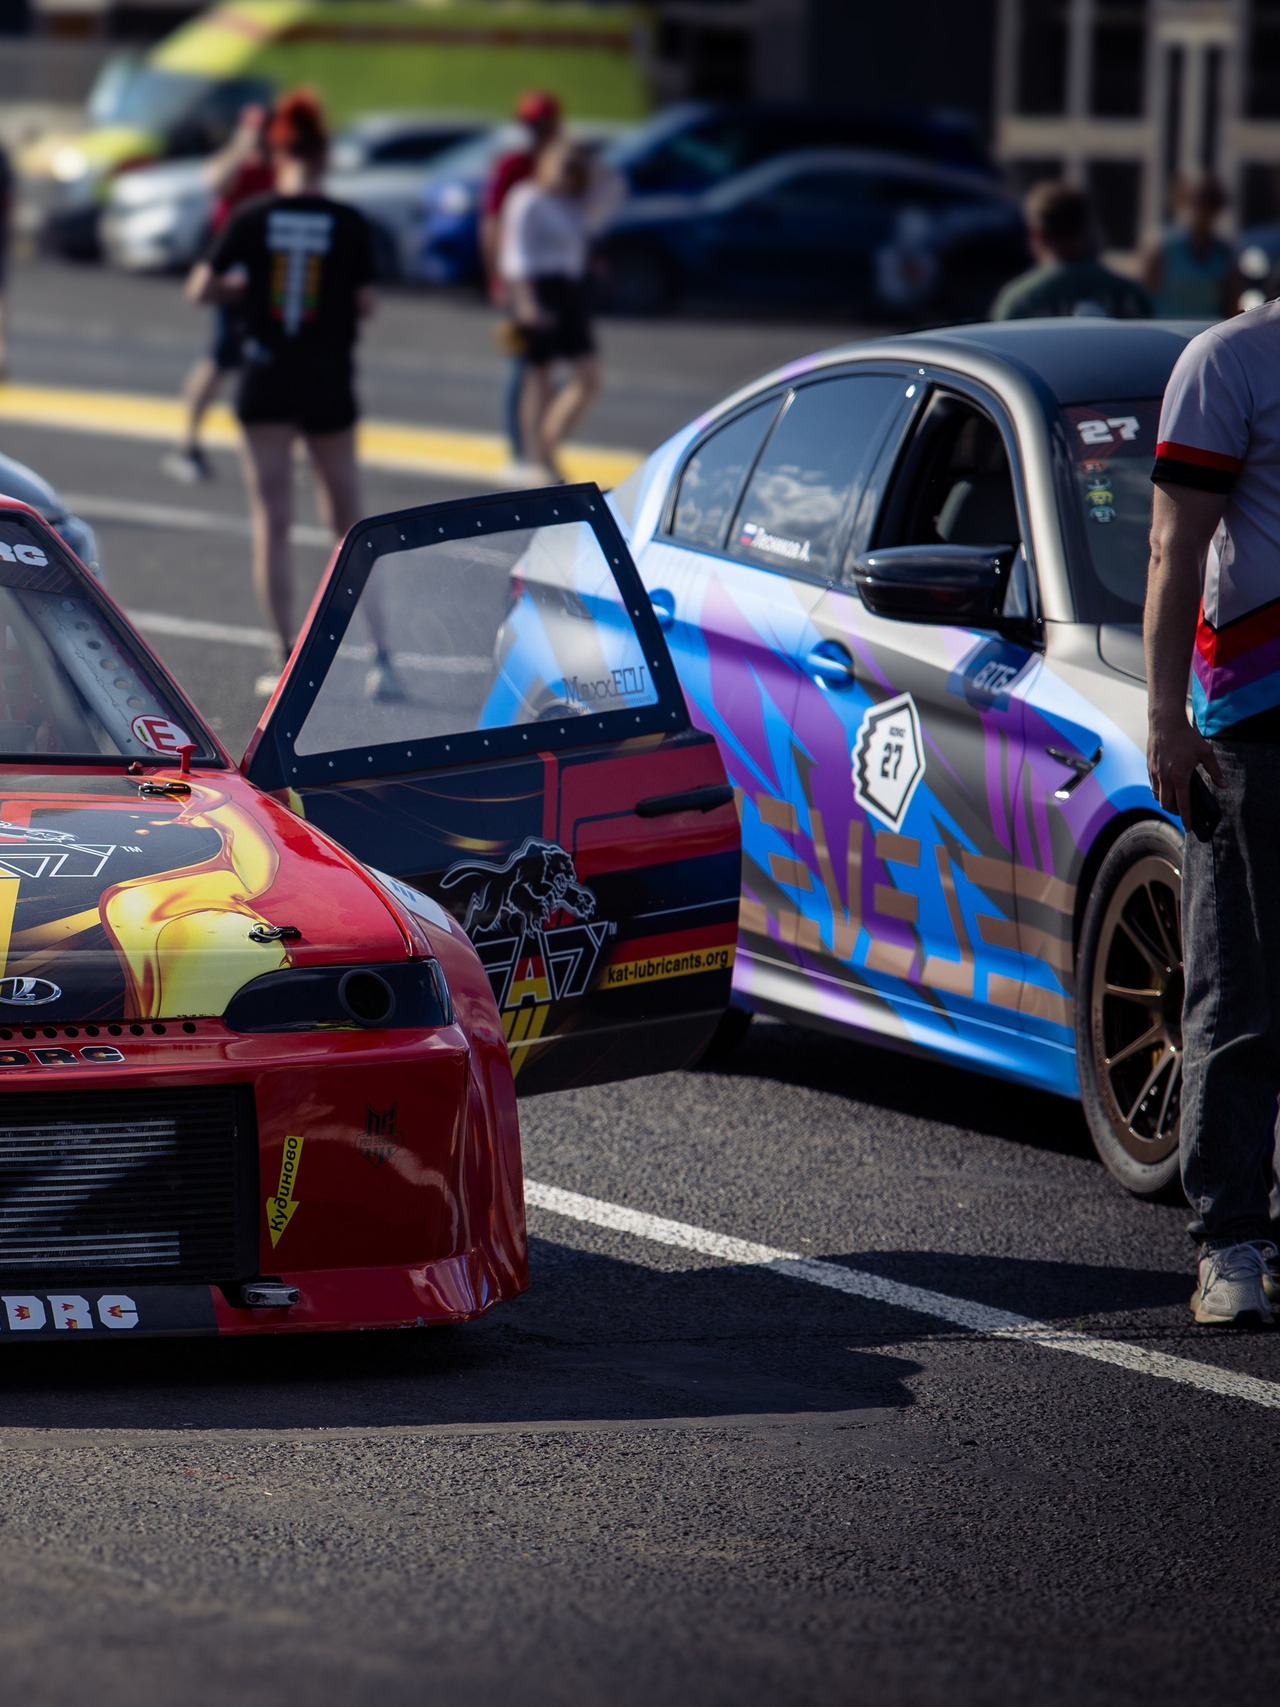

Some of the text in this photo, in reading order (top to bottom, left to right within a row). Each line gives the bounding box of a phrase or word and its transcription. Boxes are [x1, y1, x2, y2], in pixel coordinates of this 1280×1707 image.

[1077, 416, 1140, 445] 27
[563, 665, 645, 705] MaxxECU
[142, 719, 177, 751] E
[880, 742, 903, 780] 27
[608, 950, 729, 984] kat-lubricants.org
[270, 1137, 298, 1233] Кудиново
